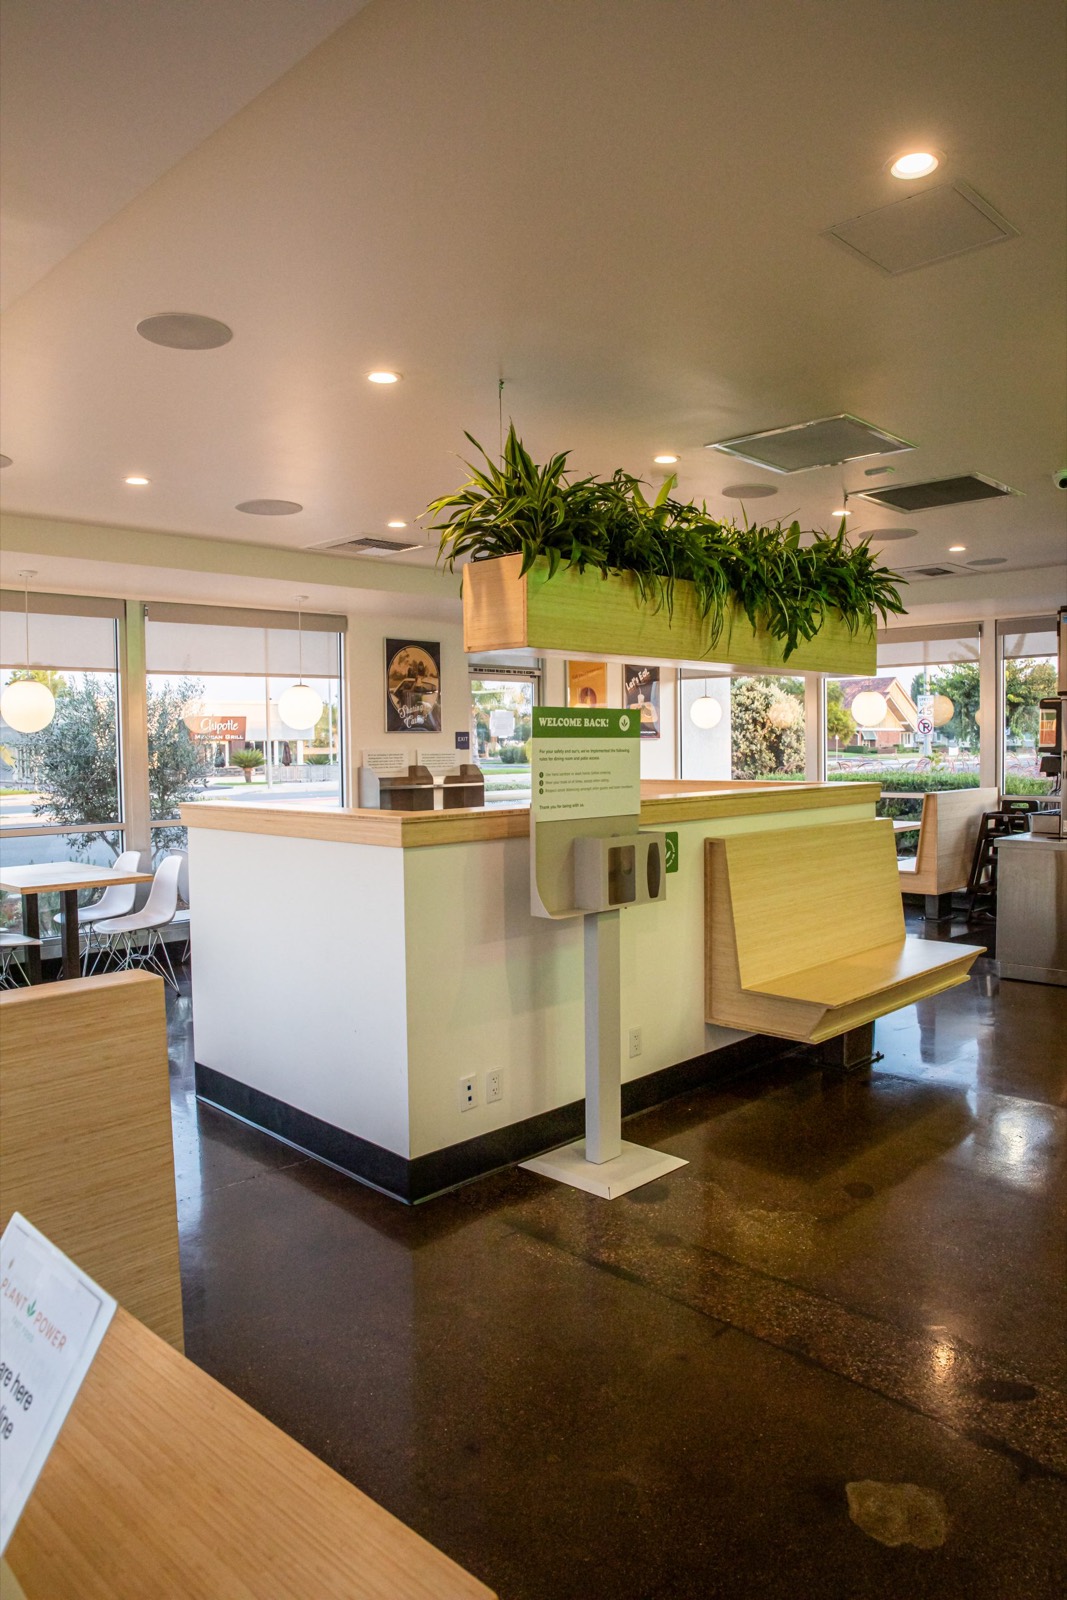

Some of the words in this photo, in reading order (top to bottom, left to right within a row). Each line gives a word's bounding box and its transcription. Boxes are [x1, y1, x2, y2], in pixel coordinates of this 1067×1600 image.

[919, 706, 932, 715] 45
[200, 717, 239, 734] Chipotle
[538, 717, 582, 727] WELCOME
[584, 718, 609, 728] BACK!
[1, 1278, 28, 1311] PLANT
[33, 1311, 67, 1352] POWER
[10, 1372, 33, 1411] here
